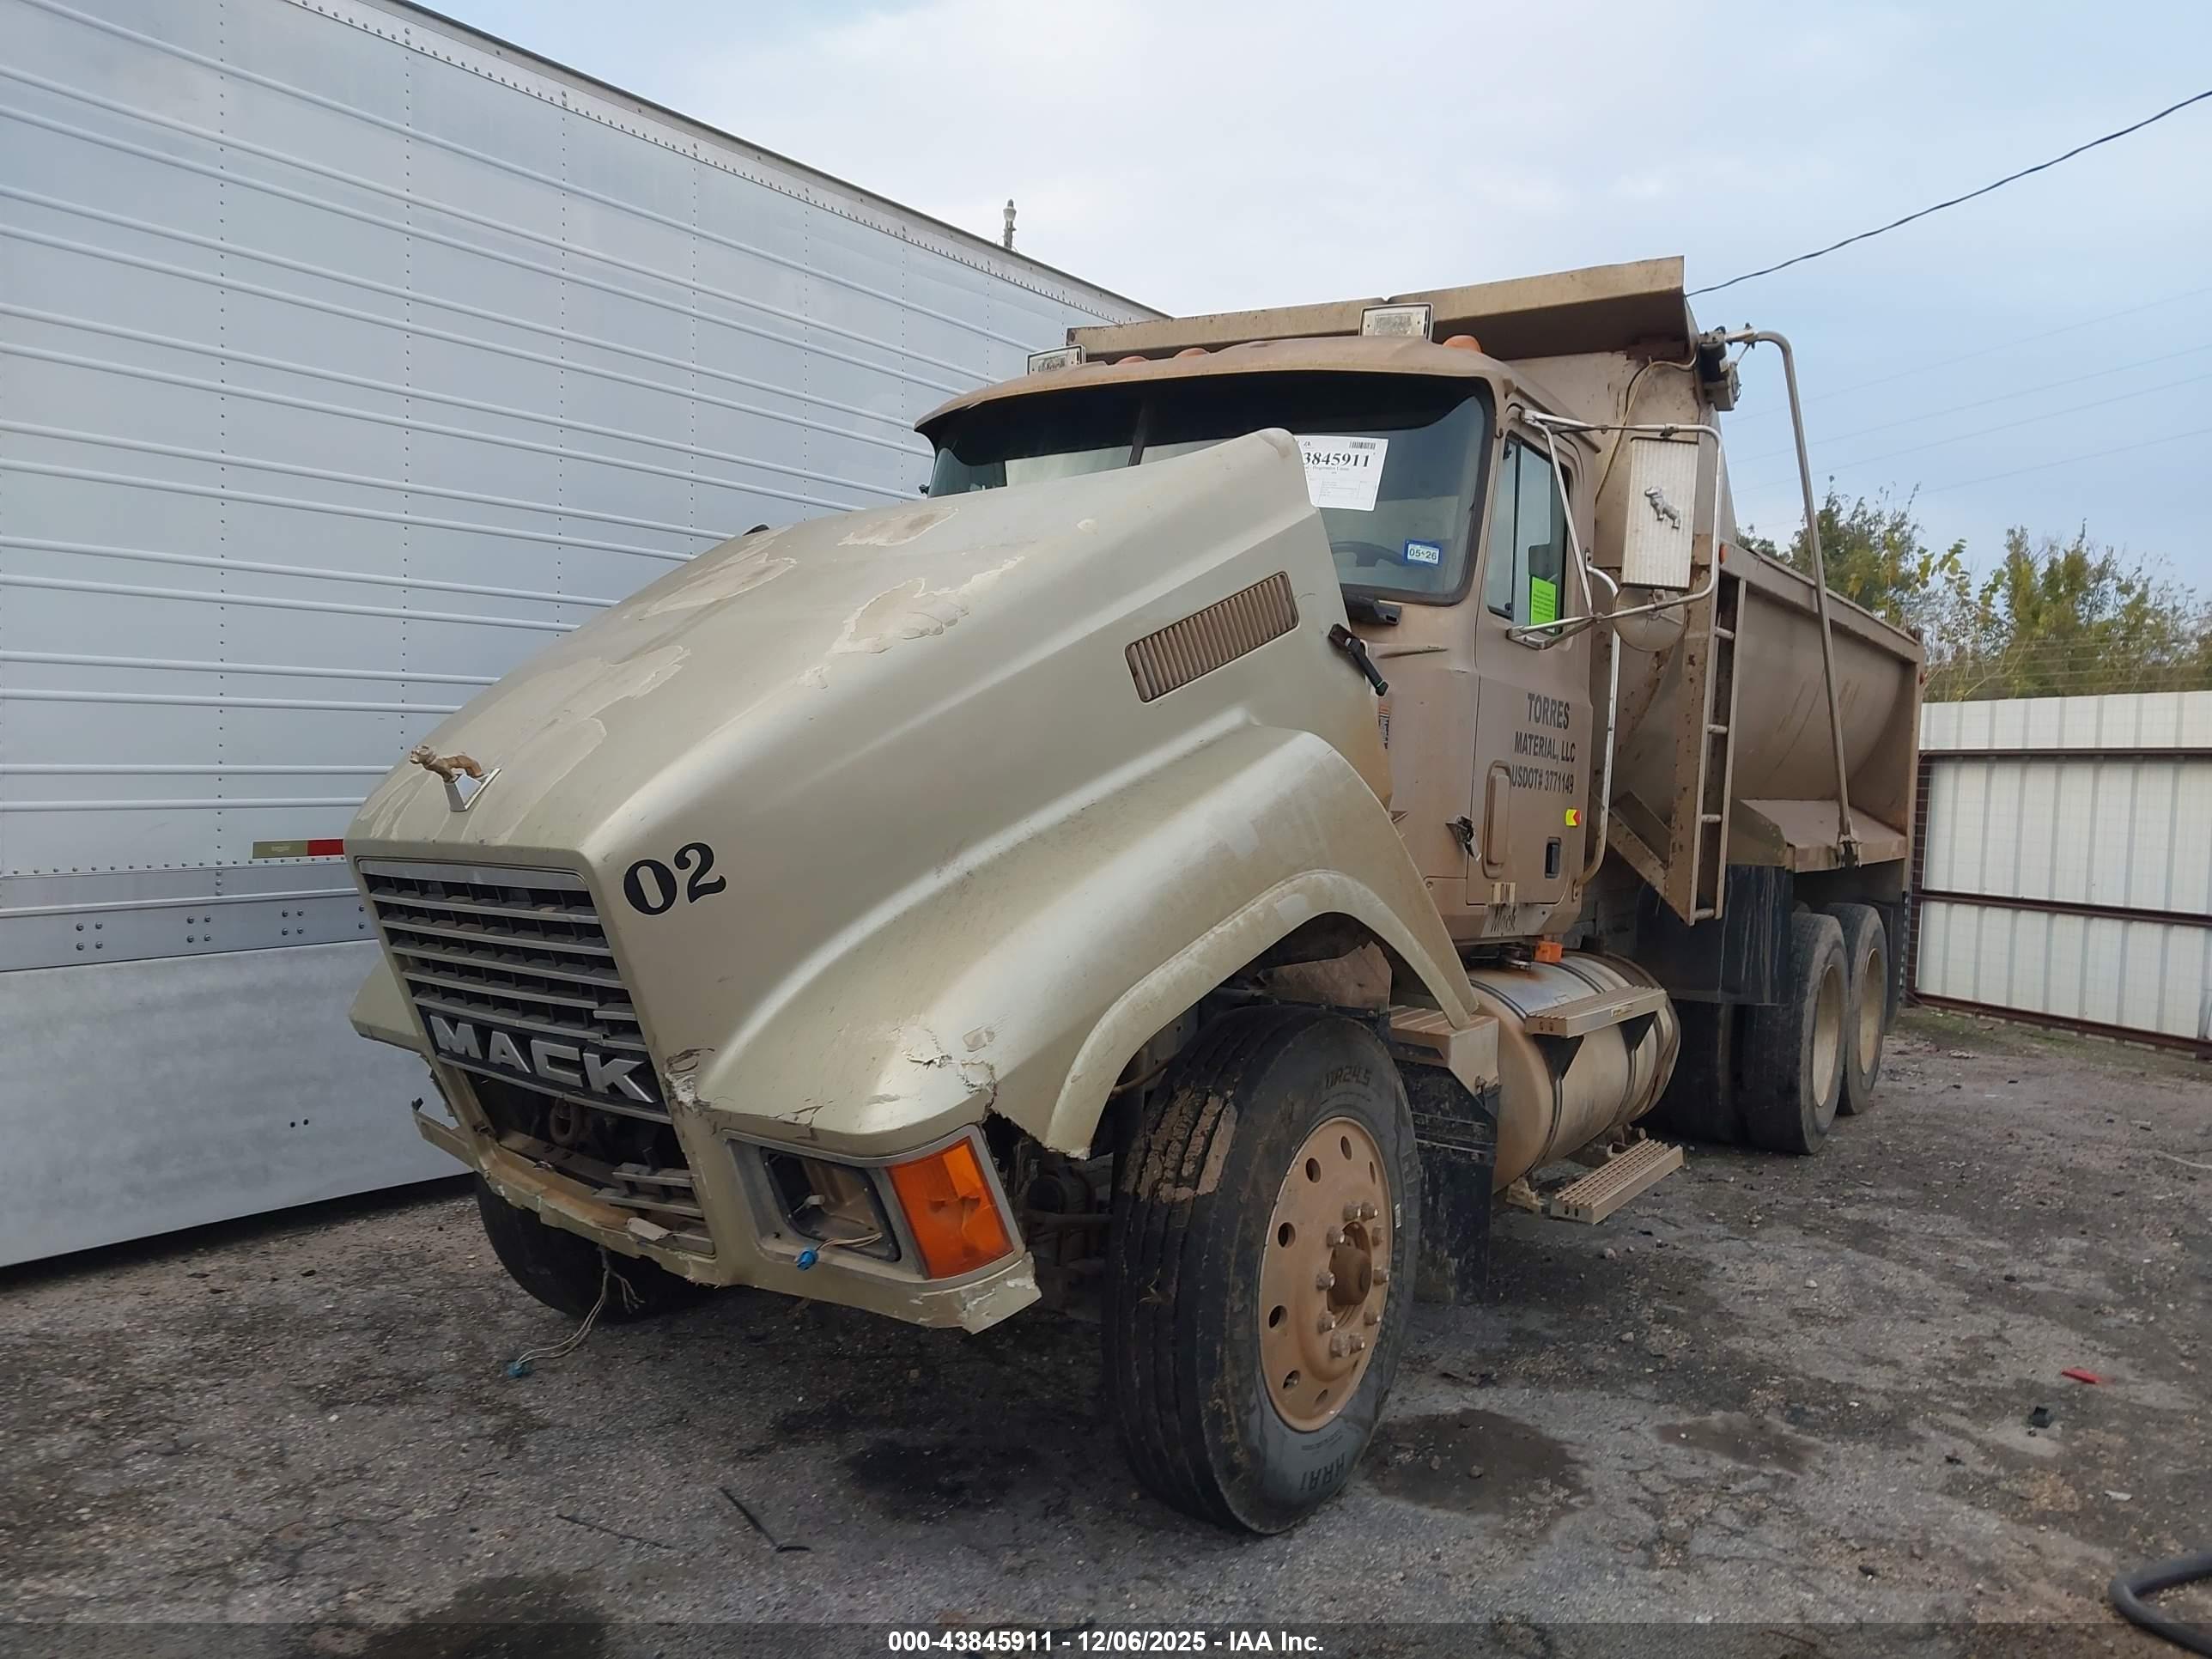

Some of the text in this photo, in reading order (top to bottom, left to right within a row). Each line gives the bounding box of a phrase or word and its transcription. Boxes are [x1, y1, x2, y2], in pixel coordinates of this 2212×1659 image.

[1528, 693, 1571, 730] TORRES
[1514, 731, 1576, 765] MATERIAL, LLC
[1511, 764, 1575, 795] USDOT# 3771149
[623, 842, 726, 915] 02
[429, 1015, 659, 1103] MACK
